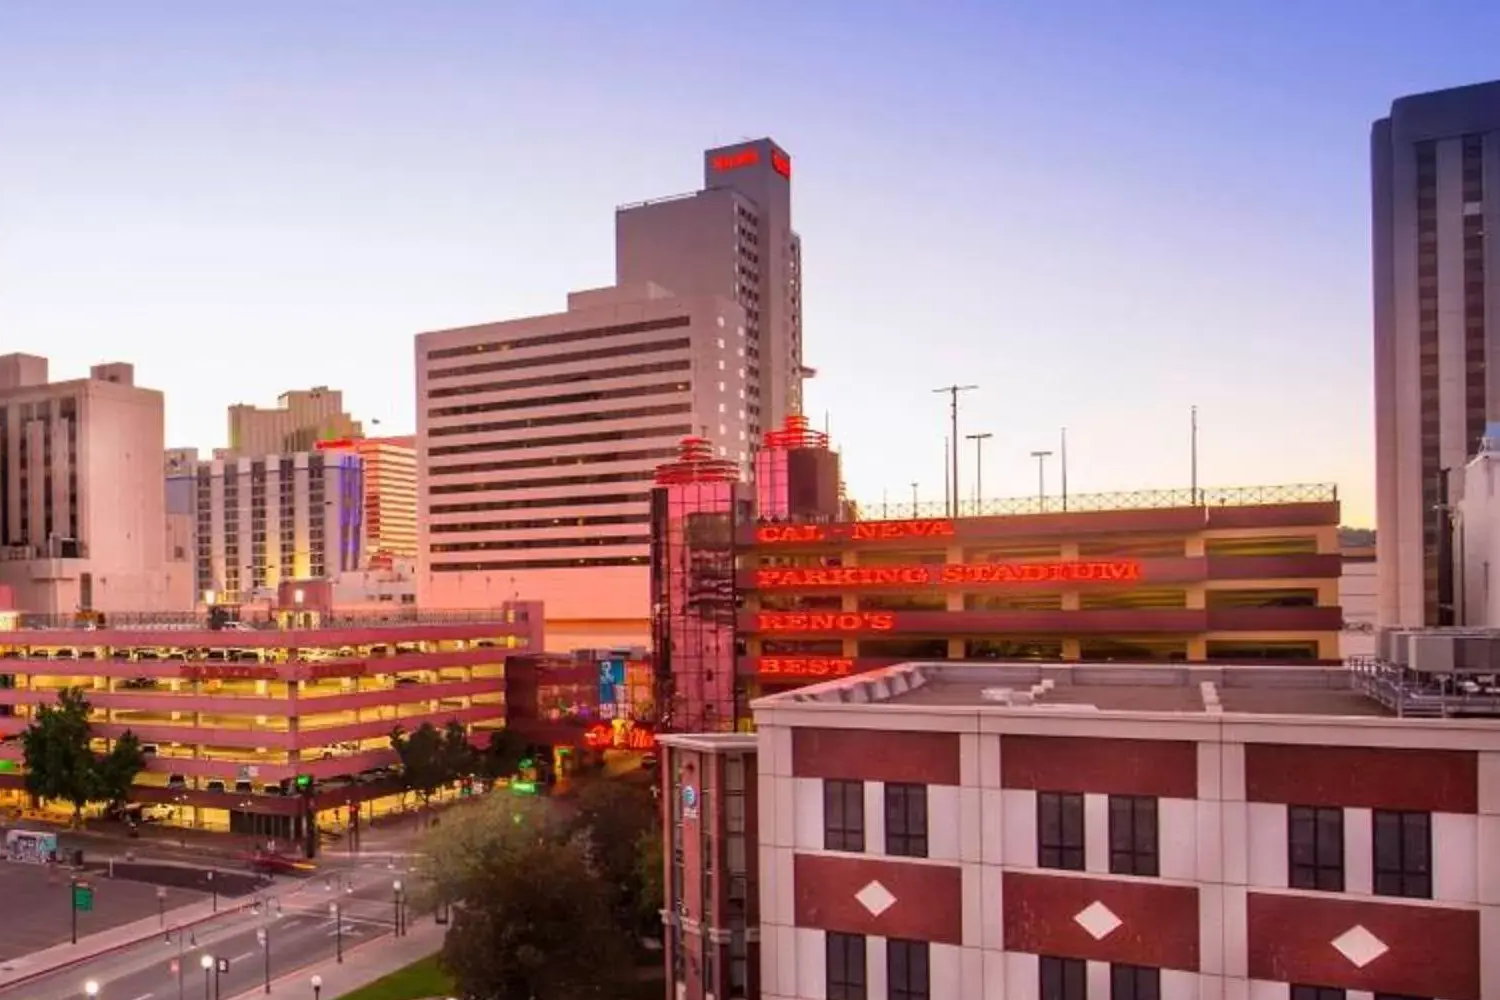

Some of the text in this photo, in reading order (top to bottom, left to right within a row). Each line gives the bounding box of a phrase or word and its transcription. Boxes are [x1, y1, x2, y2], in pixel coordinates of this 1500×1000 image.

[757, 525, 825, 541] CAL
[851, 522, 954, 540] NEVA
[757, 562, 1140, 585] PARKING STADIUM
[758, 613, 894, 630] RENO'S
[759, 658, 853, 675] BEST
